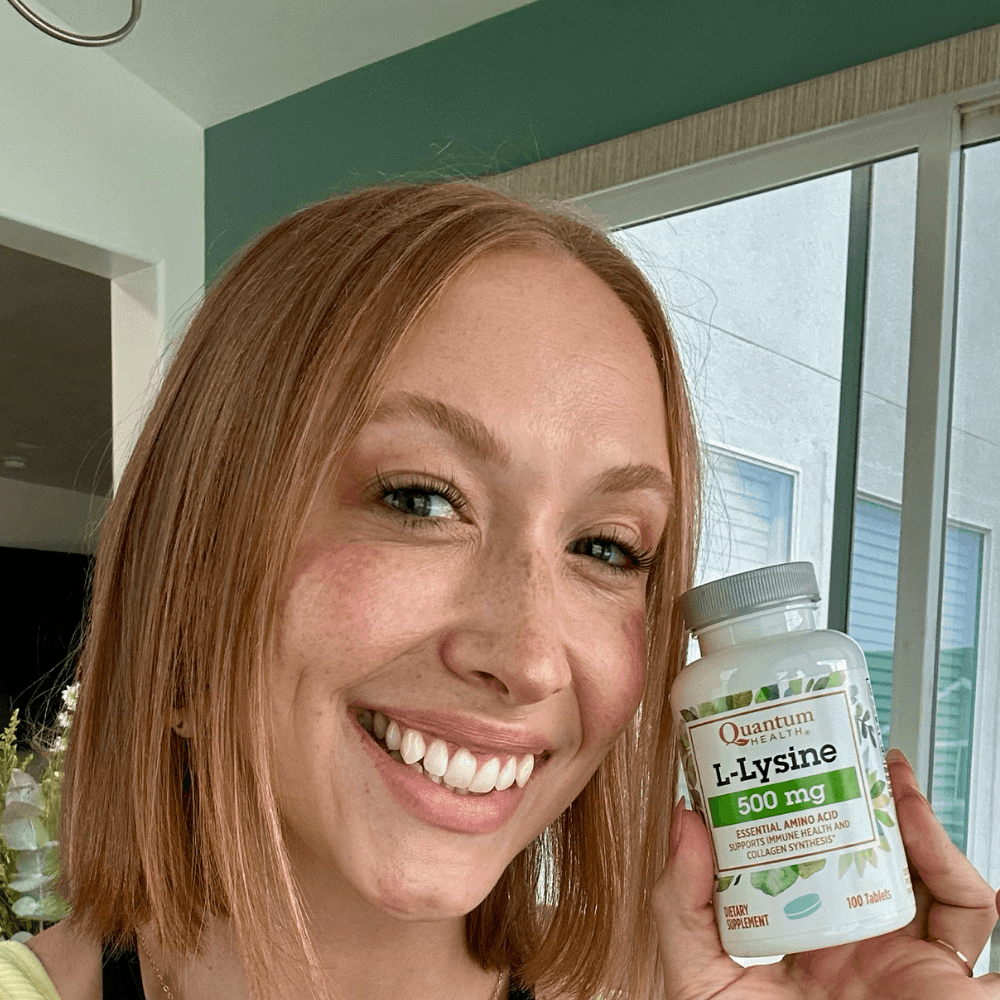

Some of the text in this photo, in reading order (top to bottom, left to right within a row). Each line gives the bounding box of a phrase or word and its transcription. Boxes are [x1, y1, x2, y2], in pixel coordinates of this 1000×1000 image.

[719, 711, 815, 746] Quantum
[751, 727, 803, 746] HEALTH
[713, 744, 837, 787] L-Lysine
[737, 784, 826, 815] 500 mg
[728, 819, 850, 852] SUPPORTS IMMUNE HEALTH AND
[736, 810, 838, 839] ESSENTIAL AMINO ACID
[747, 845, 787, 859] COLLAGEN
[846, 888, 892, 909] 100 Tablets
[723, 904, 749, 919] DIETARY
[727, 914, 770, 931] SUPPLEMENT
